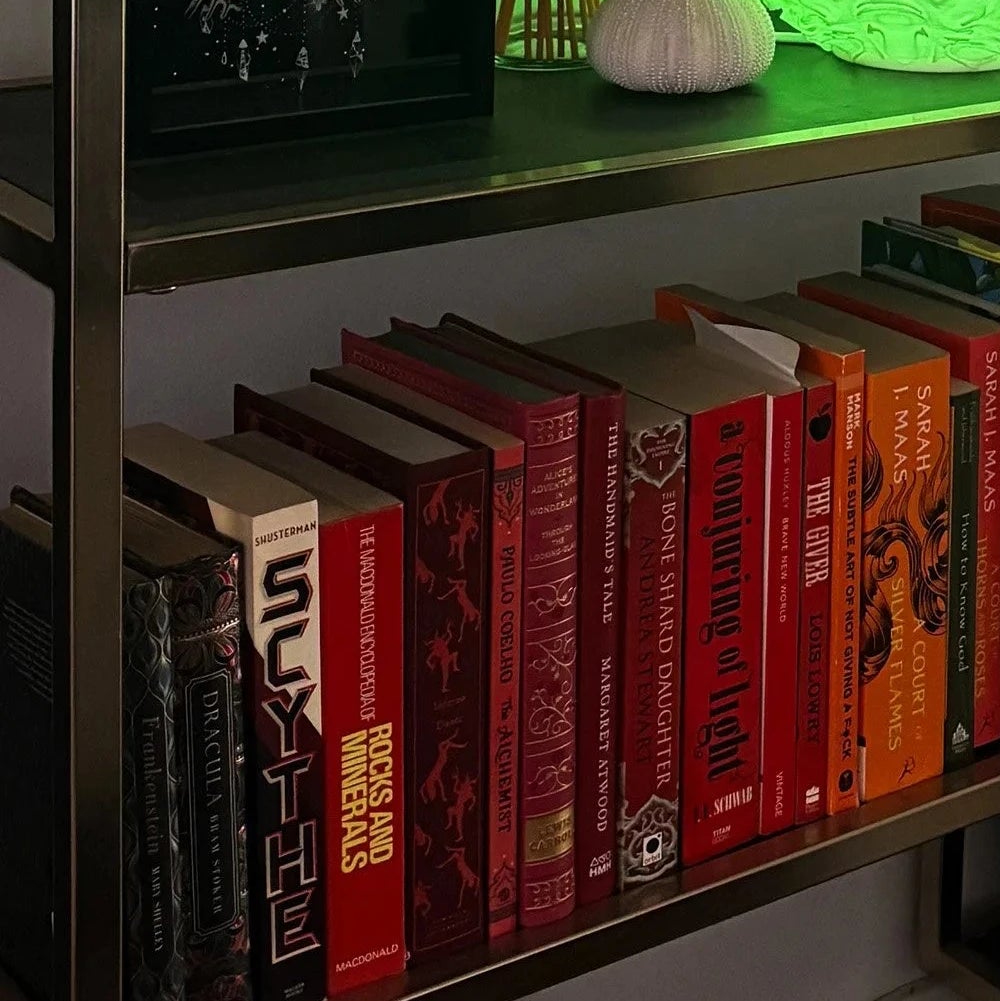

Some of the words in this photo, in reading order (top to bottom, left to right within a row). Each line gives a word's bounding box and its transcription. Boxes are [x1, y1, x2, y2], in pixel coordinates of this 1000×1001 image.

[852, 391, 862, 430] MARK
[894, 384, 909, 401] J.
[985, 350, 998, 421] SARAH
[607, 421, 619, 460] THE
[719, 419, 747, 443] a
[782, 419, 793, 464] ALDOUS
[845, 394, 855, 451] MANSON
[892, 409, 908, 486] MAAS
[917, 384, 933, 474] SARAH
[983, 430, 997, 441] J.
[661, 489, 677, 501] THE
[781, 467, 792, 509] HUXLEY
[806, 475, 831, 520] THE
[847, 457, 858, 487] THE
[983, 449, 996, 513] MAAS
[255, 520, 316, 547] SHUSTERMAN
[360, 524, 376, 548] THE
[604, 463, 619, 574] HANDMAID'S
[660, 501, 677, 567] BONE
[780, 517, 791, 552] BRAVE
[846, 489, 857, 548] SUBTLE
[960, 512, 971, 552] How
[700, 448, 753, 647] conjuring
[780, 555, 789, 580] NEW
[804, 524, 830, 588] GIVER
[845, 551, 856, 581] ART
[959, 556, 970, 575] to
[976, 537, 988, 609] THORNS
[991, 563, 1000, 575] A
[360, 548, 376, 623] MACDONALD
[500, 545, 515, 605] PAULO
[602, 577, 615, 625] TALE
[638, 536, 657, 644] ANDREA
[845, 586, 855, 608] OF
[658, 571, 676, 655] SHARD
[779, 585, 788, 623] WORLD
[844, 608, 855, 642] NOT
[890, 578, 906, 652] SILVER
[912, 618, 926, 633] A
[958, 581, 970, 629] Know
[990, 581, 1000, 642] COURT
[499, 609, 514, 684] COELHO
[717, 646, 748, 681] of
[809, 614, 824, 664] LOIS
[956, 633, 969, 671] God
[360, 625, 375, 707] ENCYCLOPEDIA
[843, 645, 854, 700] GIVING
[911, 645, 926, 716] COURT
[975, 639, 987, 699] ROSES
[360, 706, 375, 721] OF
[599, 655, 612, 753] MARGARET
[635, 650, 655, 764] STEWART
[656, 661, 674, 791] DAUGHTER
[807, 669, 822, 745] LOWRY
[842, 703, 852, 713] A
[888, 660, 904, 751] FLAMES
[202, 689, 223, 807] DRACULA
[260, 547, 321, 965] SCYTHE
[695, 679, 752, 784] light
[140, 715, 164, 856] Frankenstein
[369, 722, 394, 808] ROCKS
[341, 728, 369, 874] MINERALS
[597, 759, 609, 833] ATWOOD
[713, 785, 753, 816] SCHWAB
[775, 770, 784, 819] VINTAGE
[208, 813, 222, 855] BRAM
[369, 811, 394, 865] AND
[712, 824, 732, 838] TITAN
[151, 864, 162, 898] MARY
[210, 857, 225, 915] STOKER
[588, 859, 612, 879] HMH
[152, 900, 165, 953] SHELLEY
[335, 943, 399, 973] MACDONALD
